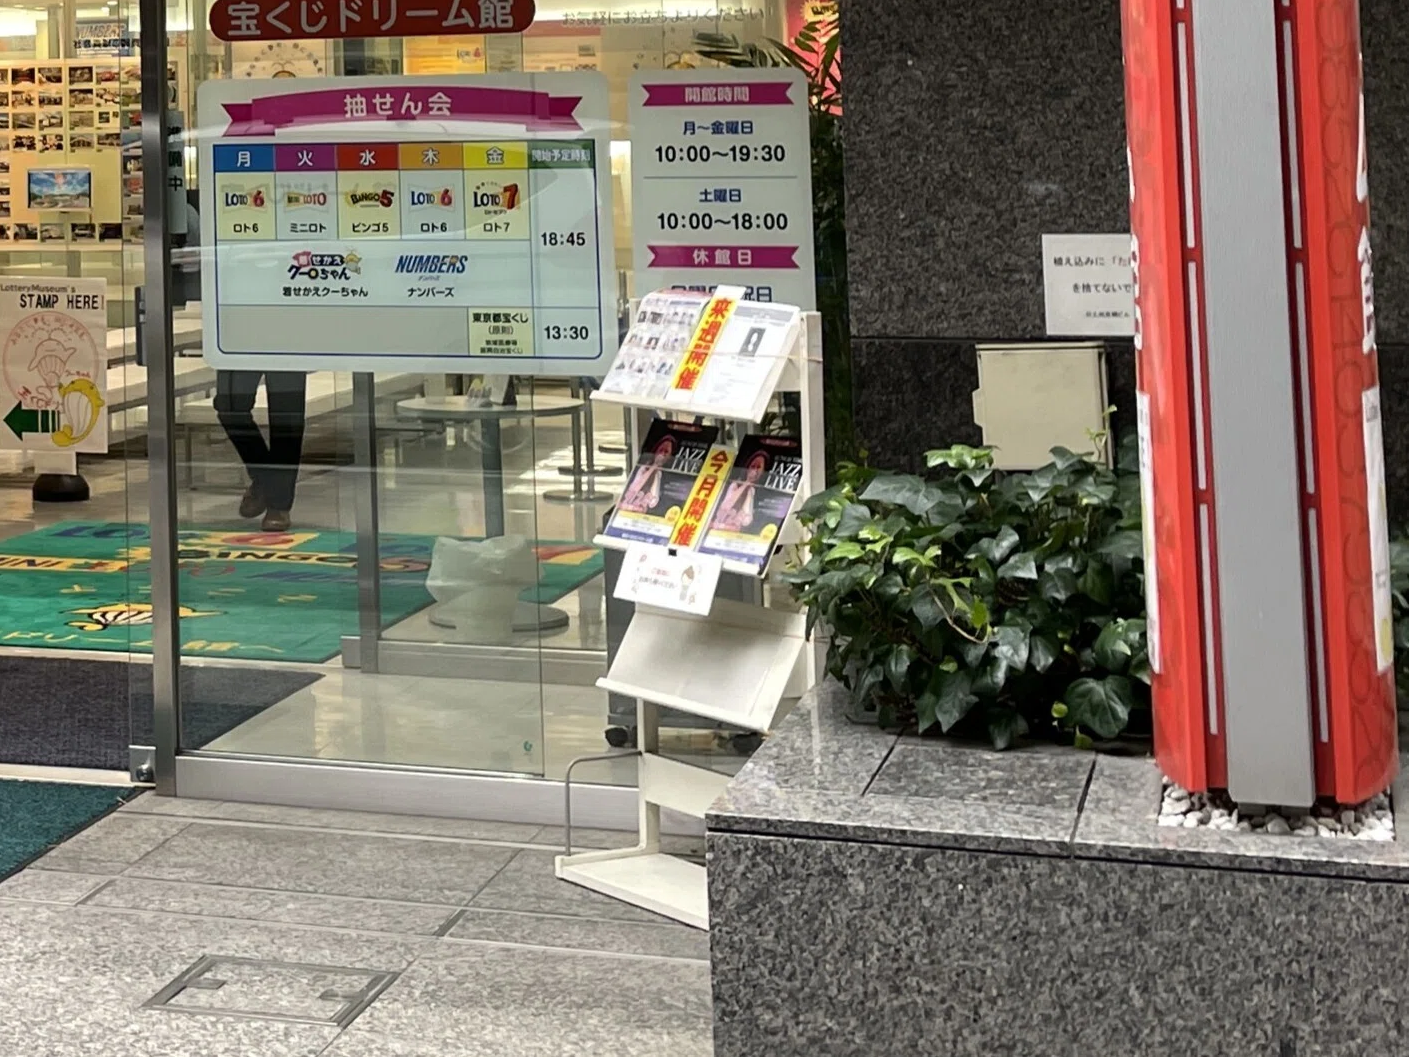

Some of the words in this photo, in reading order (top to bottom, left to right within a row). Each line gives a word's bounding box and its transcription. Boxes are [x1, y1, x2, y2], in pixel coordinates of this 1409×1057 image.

[684, 86, 750, 103] 開館時間
[343, 92, 452, 118] 抽せん会
[683, 120, 754, 136] 月〜金曜日
[236, 150, 252, 168] 月
[297, 149, 314, 167] 火
[359, 149, 377, 166] 水
[422, 147, 440, 166] 木
[485, 145, 505, 165] 金
[225, 192, 248, 207] LOTO
[252, 189, 266, 208] 6
[411, 190, 436, 206] LOTO
[440, 188, 453, 207] 6
[473, 190, 501, 208] LOTO
[698, 188, 742, 203] 土曜日
[233, 223, 259, 233] ロト6
[290, 223, 327, 233] ミニロト
[352, 223, 389, 233] ビンゴ5
[420, 222, 448, 232] ロト6
[483, 222, 510, 232] ロト7
[540, 232, 586, 246] 18:45
[395, 254, 468, 275] NUMBERS
[692, 248, 753, 265] 休館日
[282, 286, 369, 298] 着せかえクーちゃん
[407, 286, 455, 298] ナンバーズ
[19, 294, 59, 309] STAMP
[67, 294, 105, 310] HERE!
[472, 312, 529, 324] 東京都宝くじ
[544, 325, 589, 340] 13:30
[675, 297, 733, 391] 来週開催
[675, 446, 706, 462] JAZZ
[671, 458, 703, 475] LIVE
[769, 461, 802, 479] JAZZ
[764, 473, 799, 492] LIVE
[674, 449, 729, 547] 今月開催
